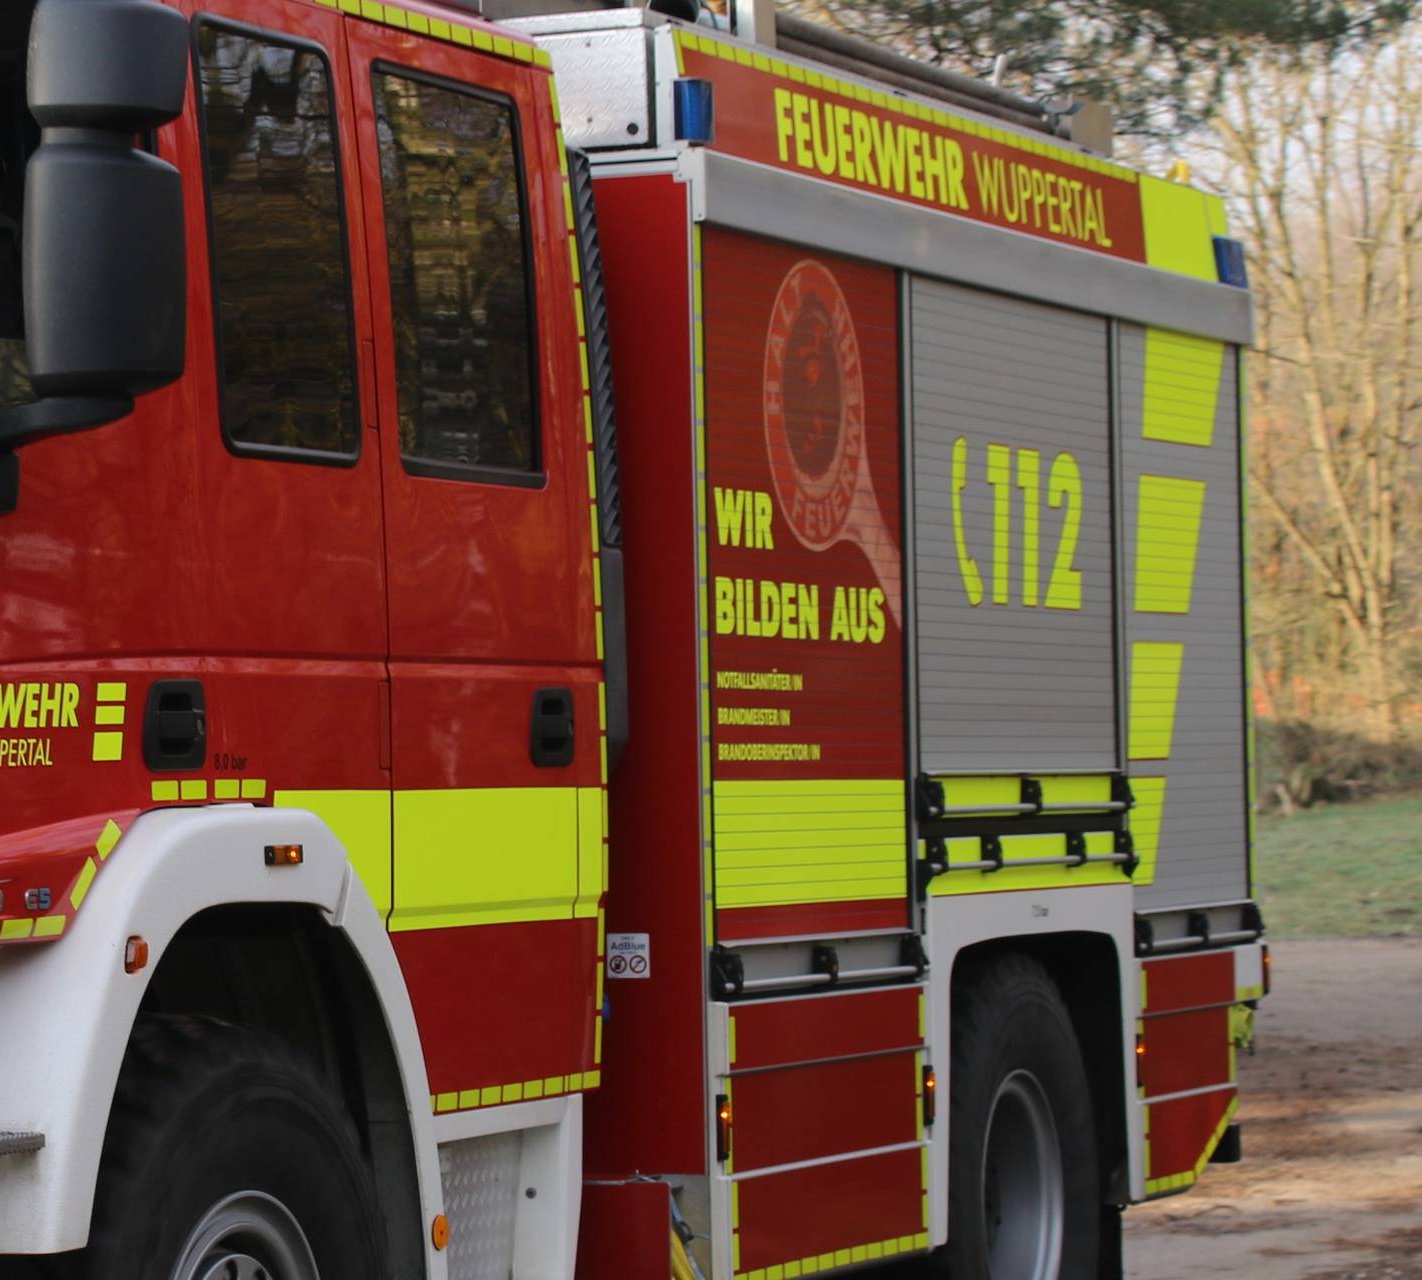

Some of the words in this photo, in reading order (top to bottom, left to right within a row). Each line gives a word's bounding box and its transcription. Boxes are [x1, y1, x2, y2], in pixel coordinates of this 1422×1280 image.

[774, 87, 970, 211] FEUERWEHR
[972, 150, 1113, 248] WUPPERTAL
[713, 487, 774, 550] WIR
[986, 442, 1083, 611] 112
[715, 576, 820, 641] BILDEN
[830, 586, 886, 644] AUS
[231, 753, 247, 770] bar
[25, 887, 51, 910] E5
[611, 941, 646, 951] AdBlue
